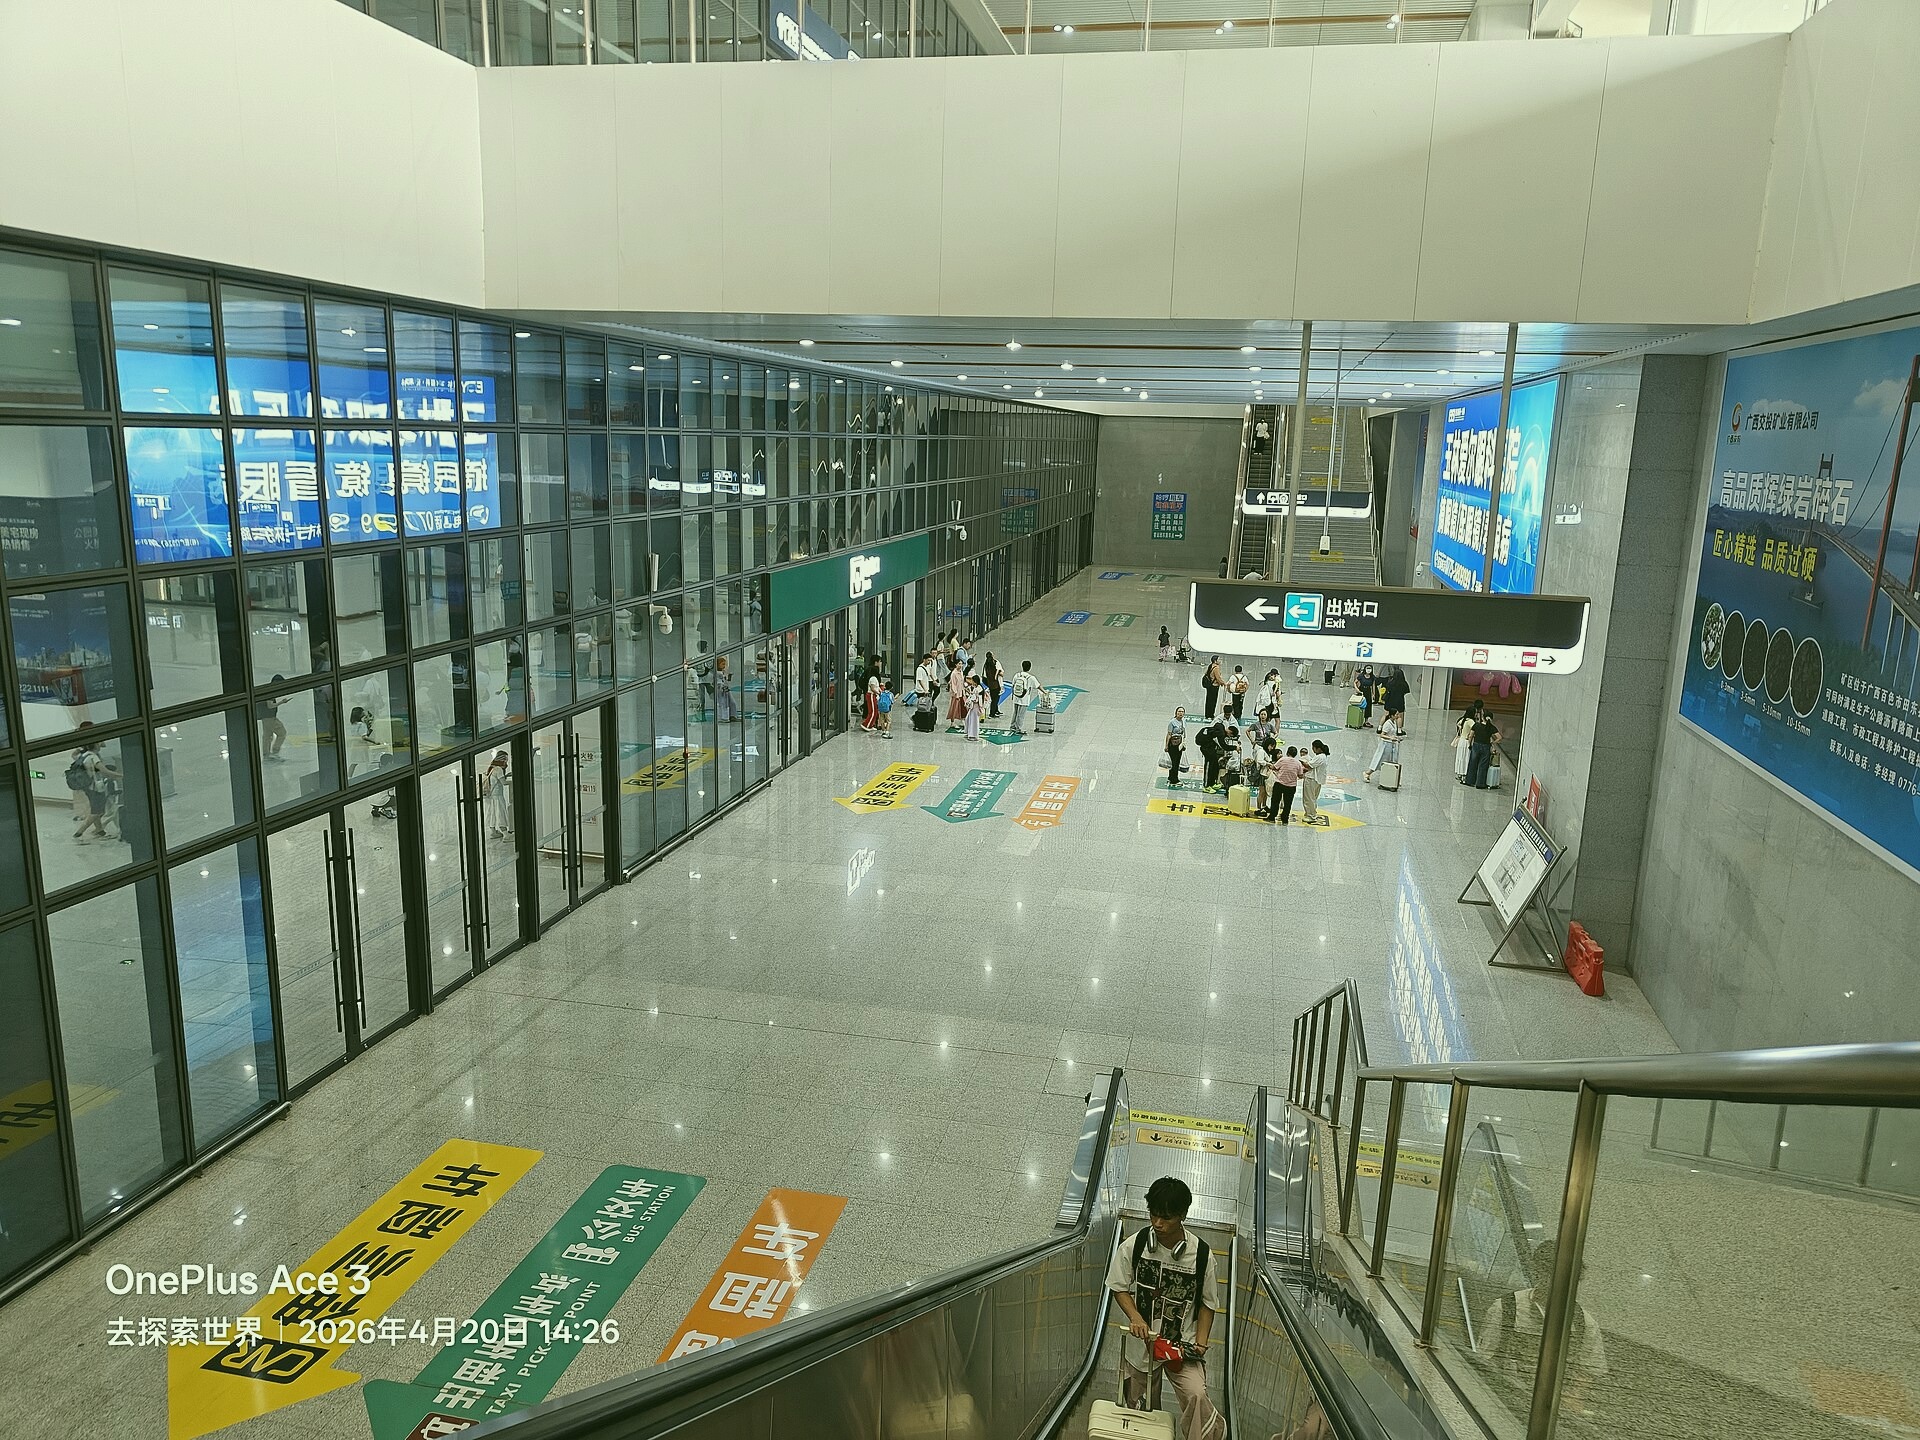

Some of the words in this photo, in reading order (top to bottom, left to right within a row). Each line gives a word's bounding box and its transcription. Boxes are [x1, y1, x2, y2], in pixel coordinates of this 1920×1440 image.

[1745, 411, 1819, 431] 广西交投矿业有限公司
[1720, 469, 1854, 526] 高品质辉绿岩碎石
[1712, 528, 1757, 567] 匠心精选
[1761, 538, 1818, 582] 品质过硬
[1326, 597, 1379, 618] 出站口
[1325, 618, 1346, 630] Exit
[1740, 690, 1756, 706] 3-5mm
[1762, 702, 1782, 720] 5-10mm
[1786, 716, 1811, 737] 10-15mm
[1874, 762, 1897, 786] 李经理
[583, 1178, 659, 1242] 公交车
[622, 1216, 645, 1244] BUS
[635, 1184, 676, 1221] STATION
[486, 1382, 522, 1416] TAXI
[564, 1281, 602, 1319] POINT
